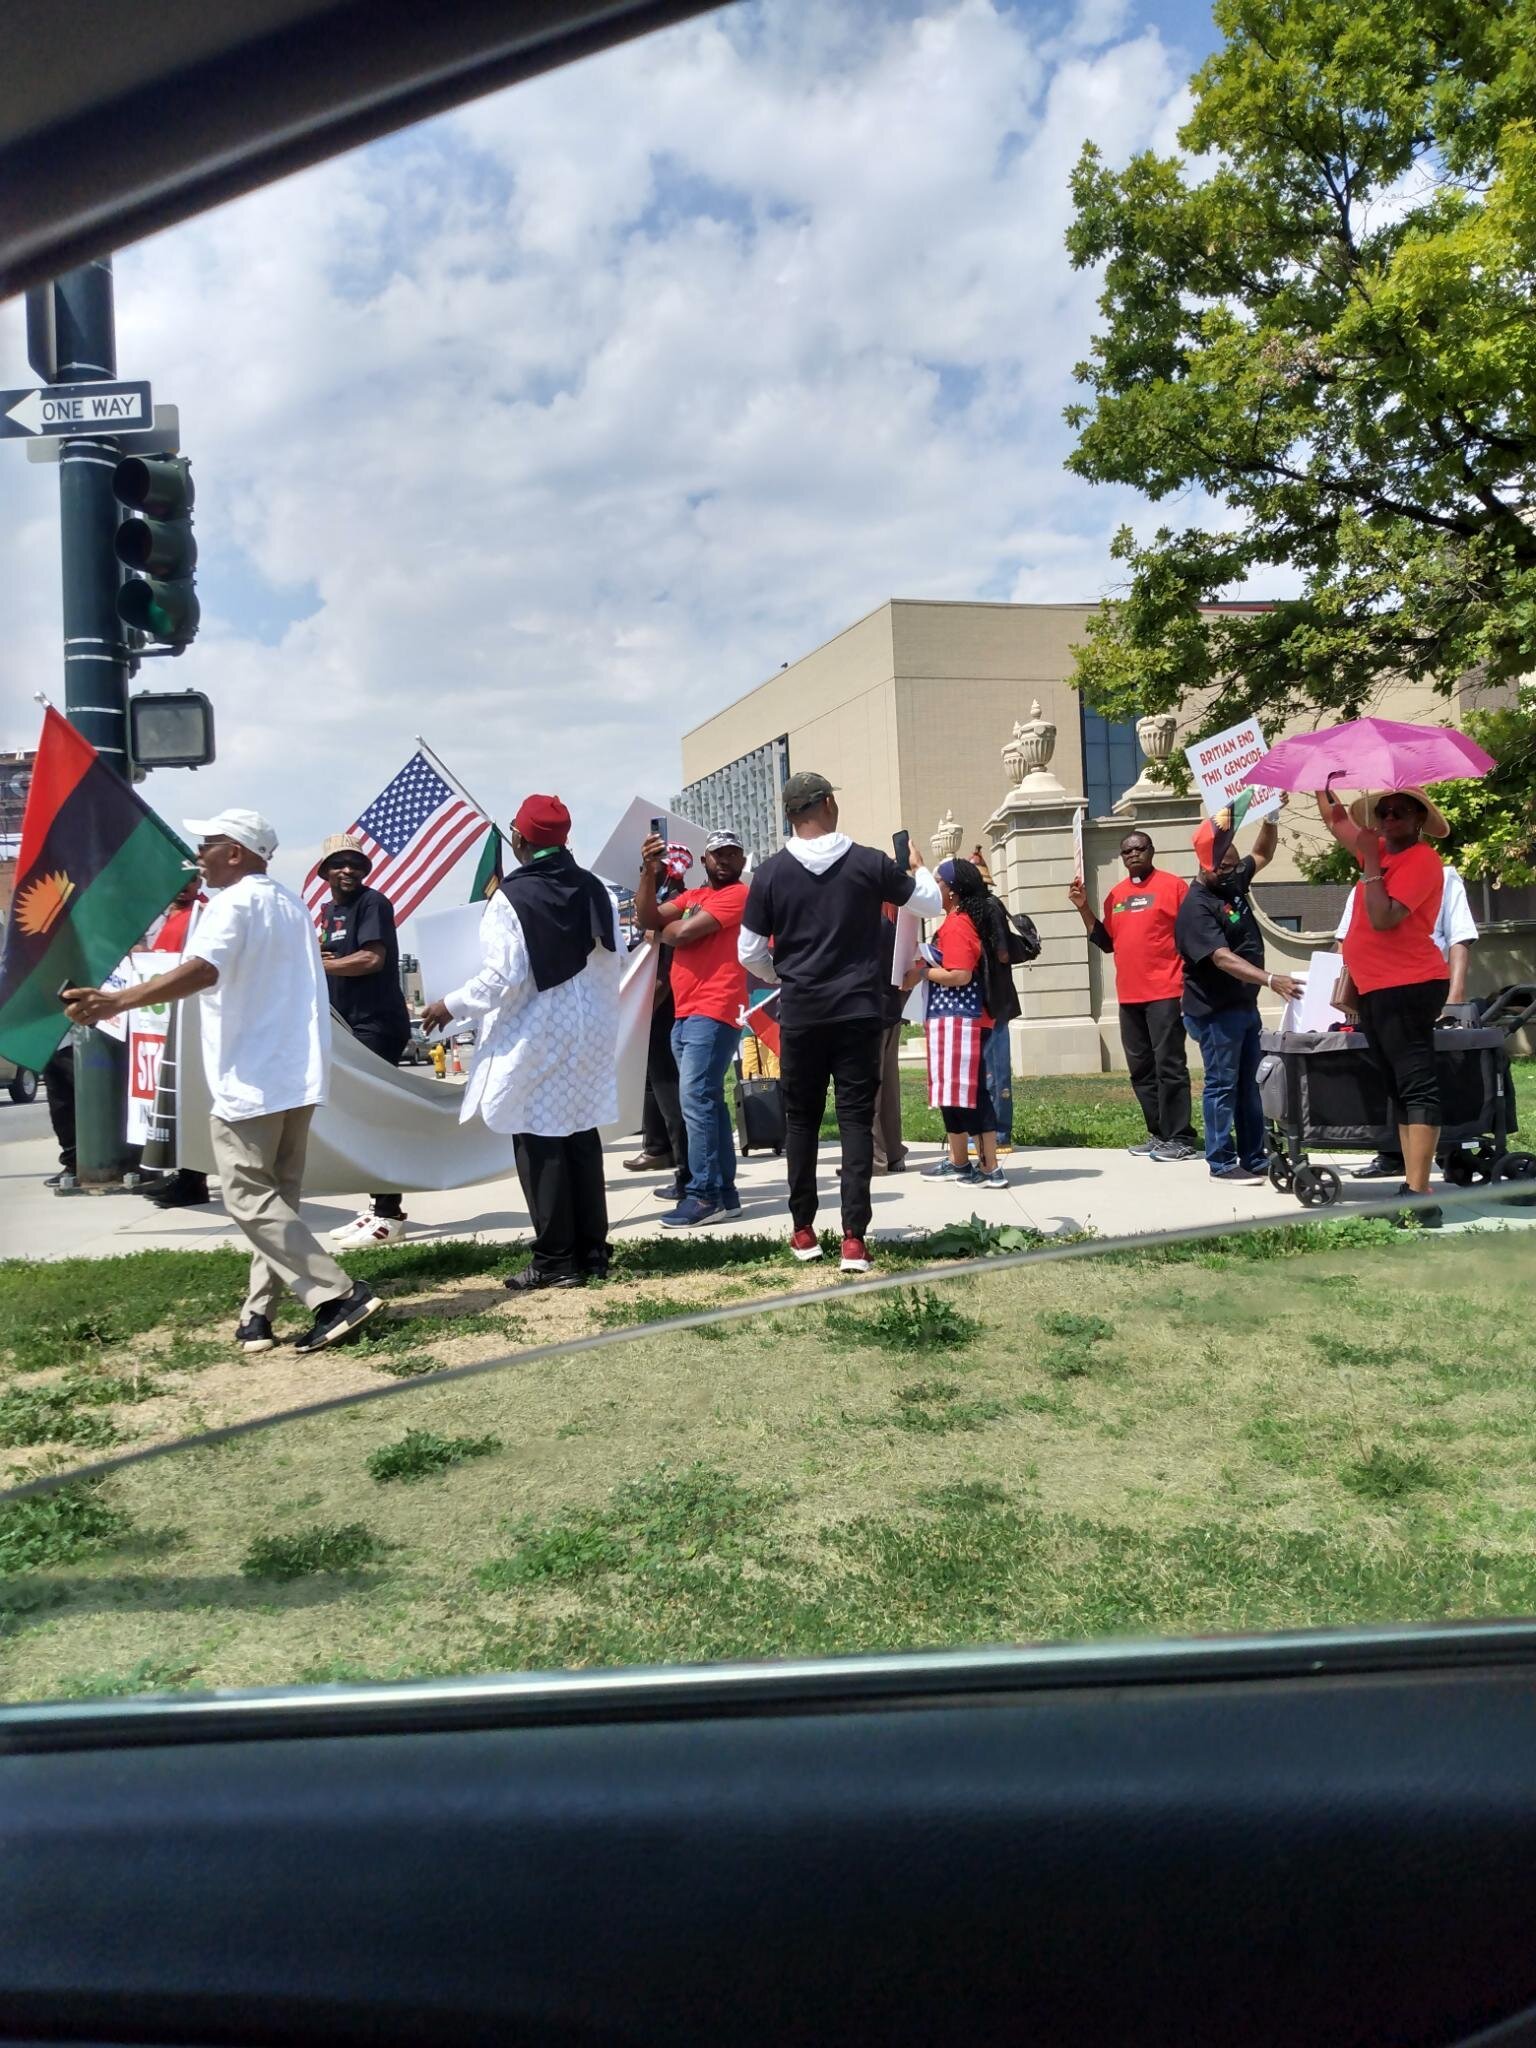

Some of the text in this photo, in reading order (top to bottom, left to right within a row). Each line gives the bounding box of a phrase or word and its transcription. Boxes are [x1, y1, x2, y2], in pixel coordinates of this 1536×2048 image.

[43, 397, 135, 421] ONE WAY
[1199, 730, 1255, 766] BRITIAN END
[1201, 768, 1223, 787] THIS
